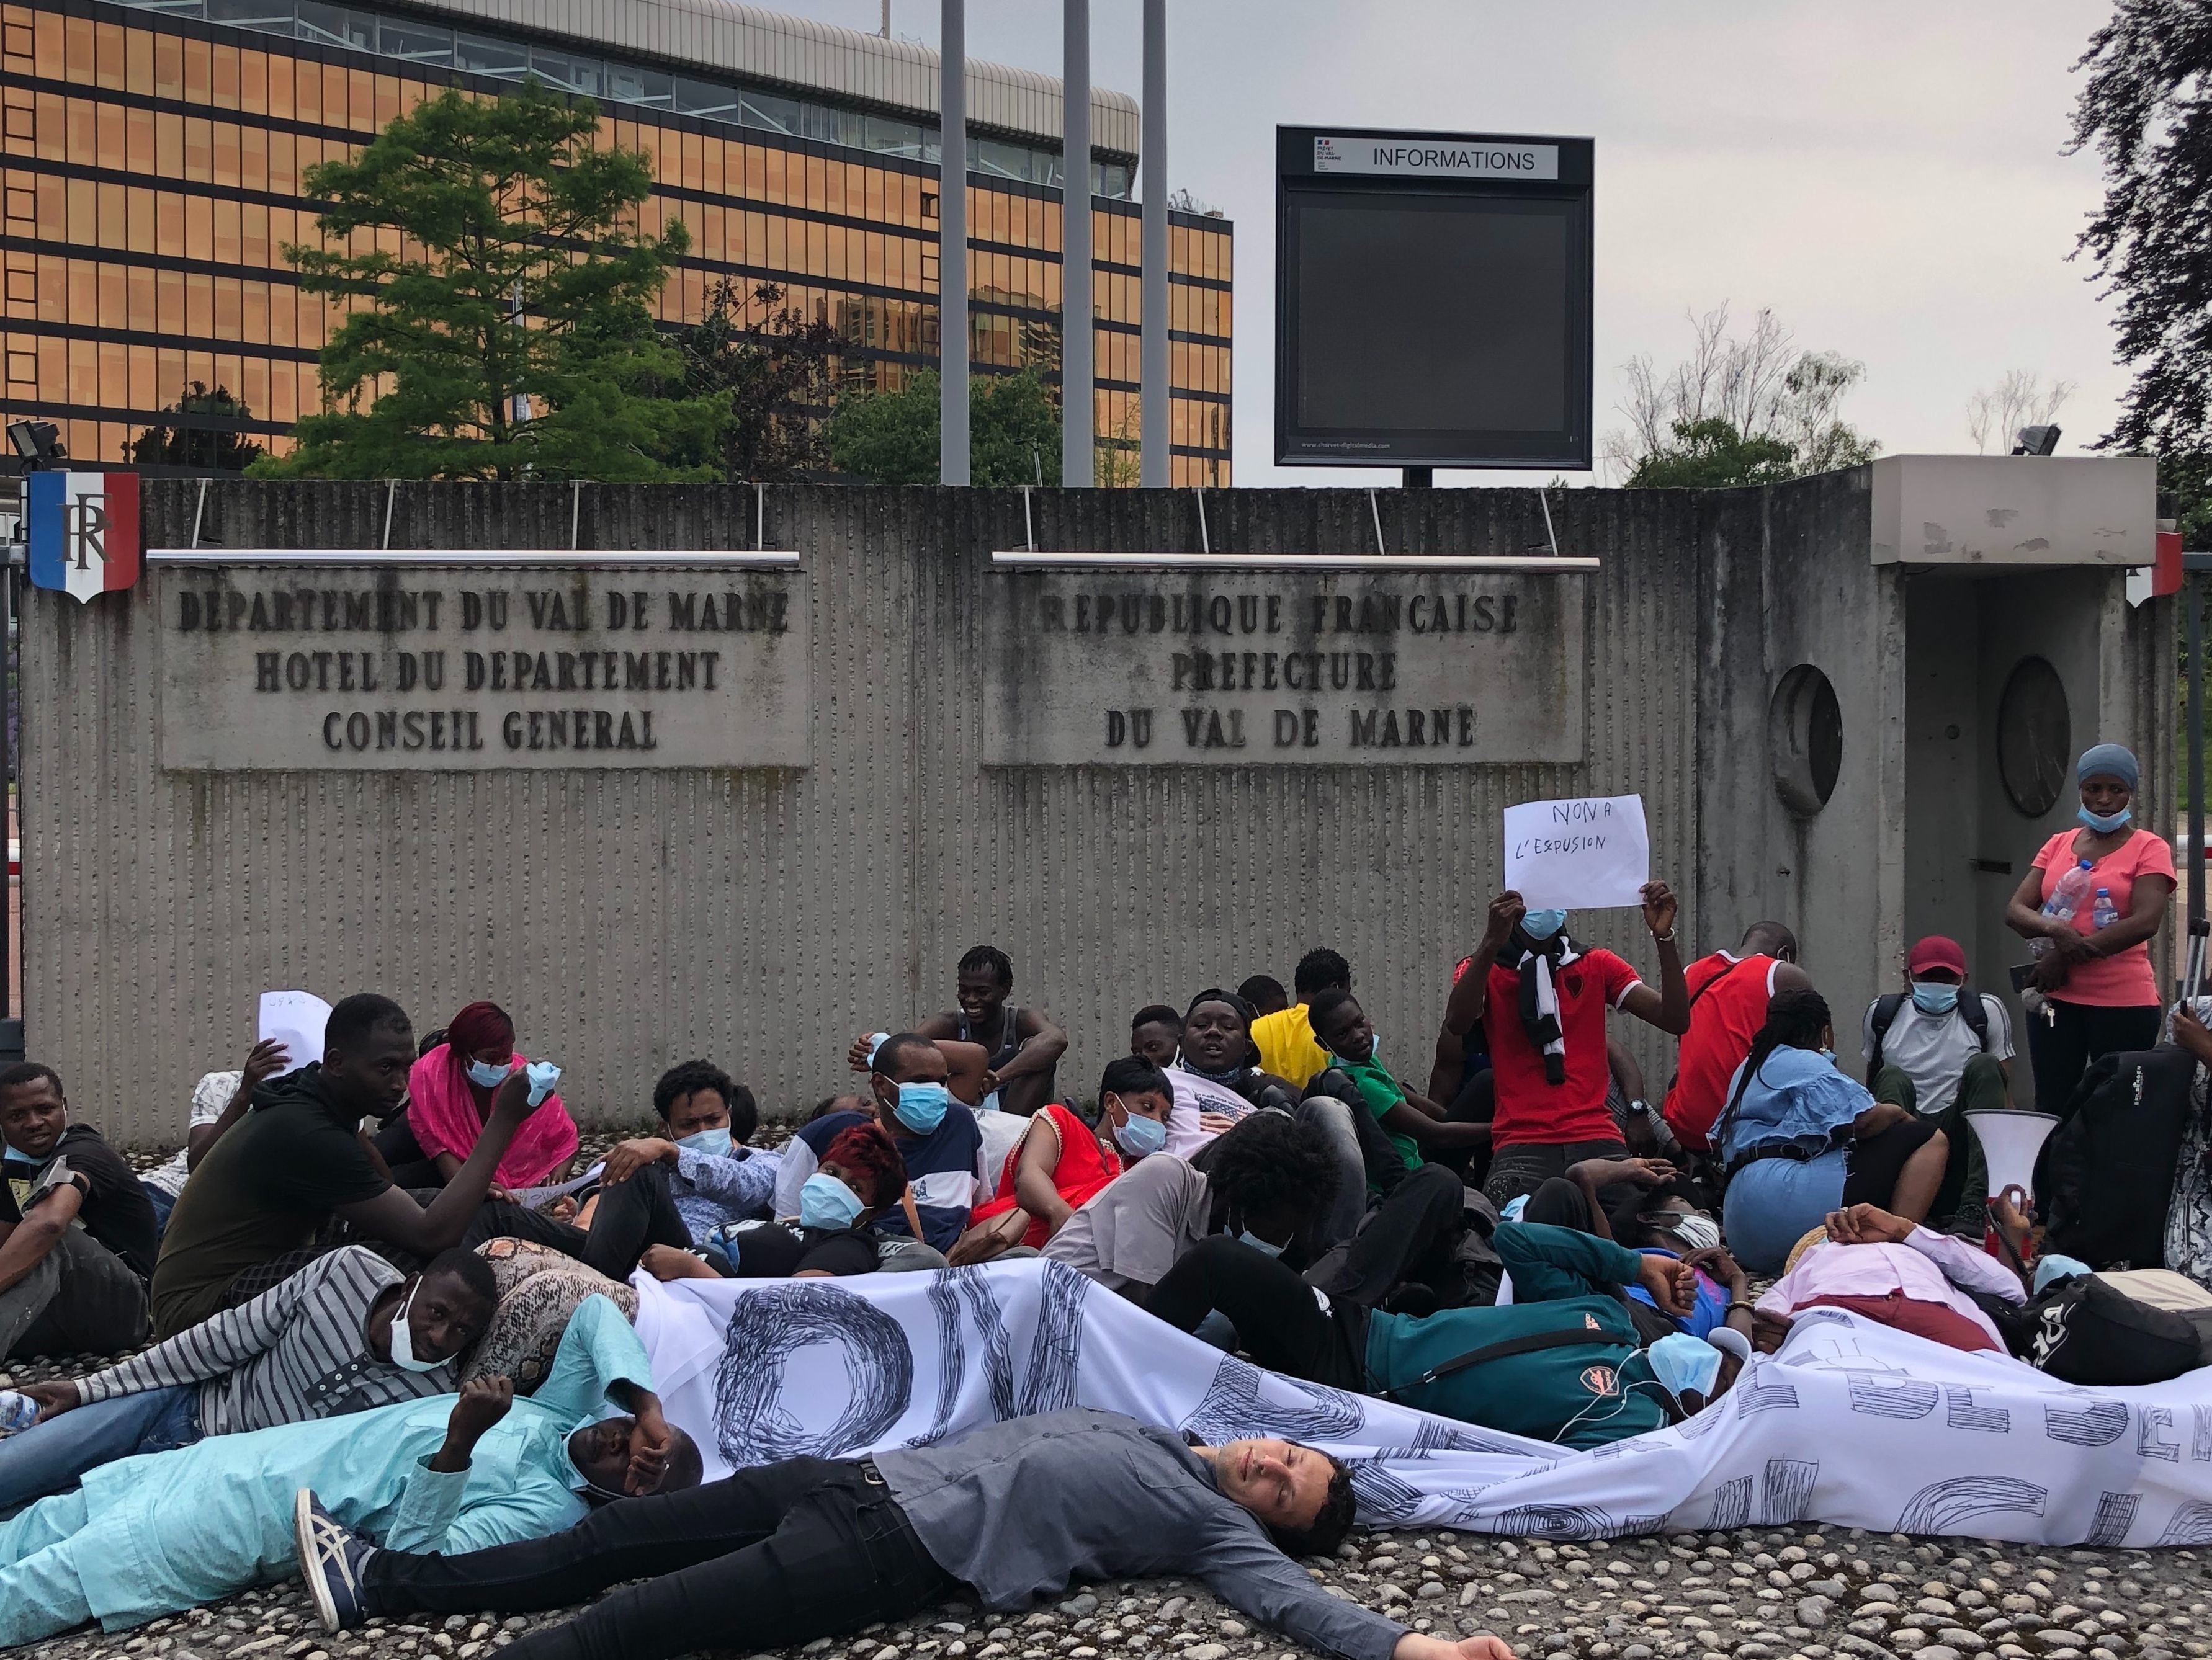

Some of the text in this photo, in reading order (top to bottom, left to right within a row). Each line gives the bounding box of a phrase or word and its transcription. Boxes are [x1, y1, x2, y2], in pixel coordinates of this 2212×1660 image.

[1373, 148, 1536, 171] INFORMATIONS
[179, 590, 789, 631] DEPARTEMENT DU VAL DE MARNE
[1041, 594, 1518, 635] REPUBLIQUE FRANCAISE
[254, 651, 719, 692] HOTEL DU DEPARTEMENT
[1171, 652, 1397, 691] PREFECTURE
[323, 710, 658, 751] CONSEIL GENERAL
[1106, 709, 1474, 748] DU VAL DE MARNE
[1552, 801, 1598, 825] NON
